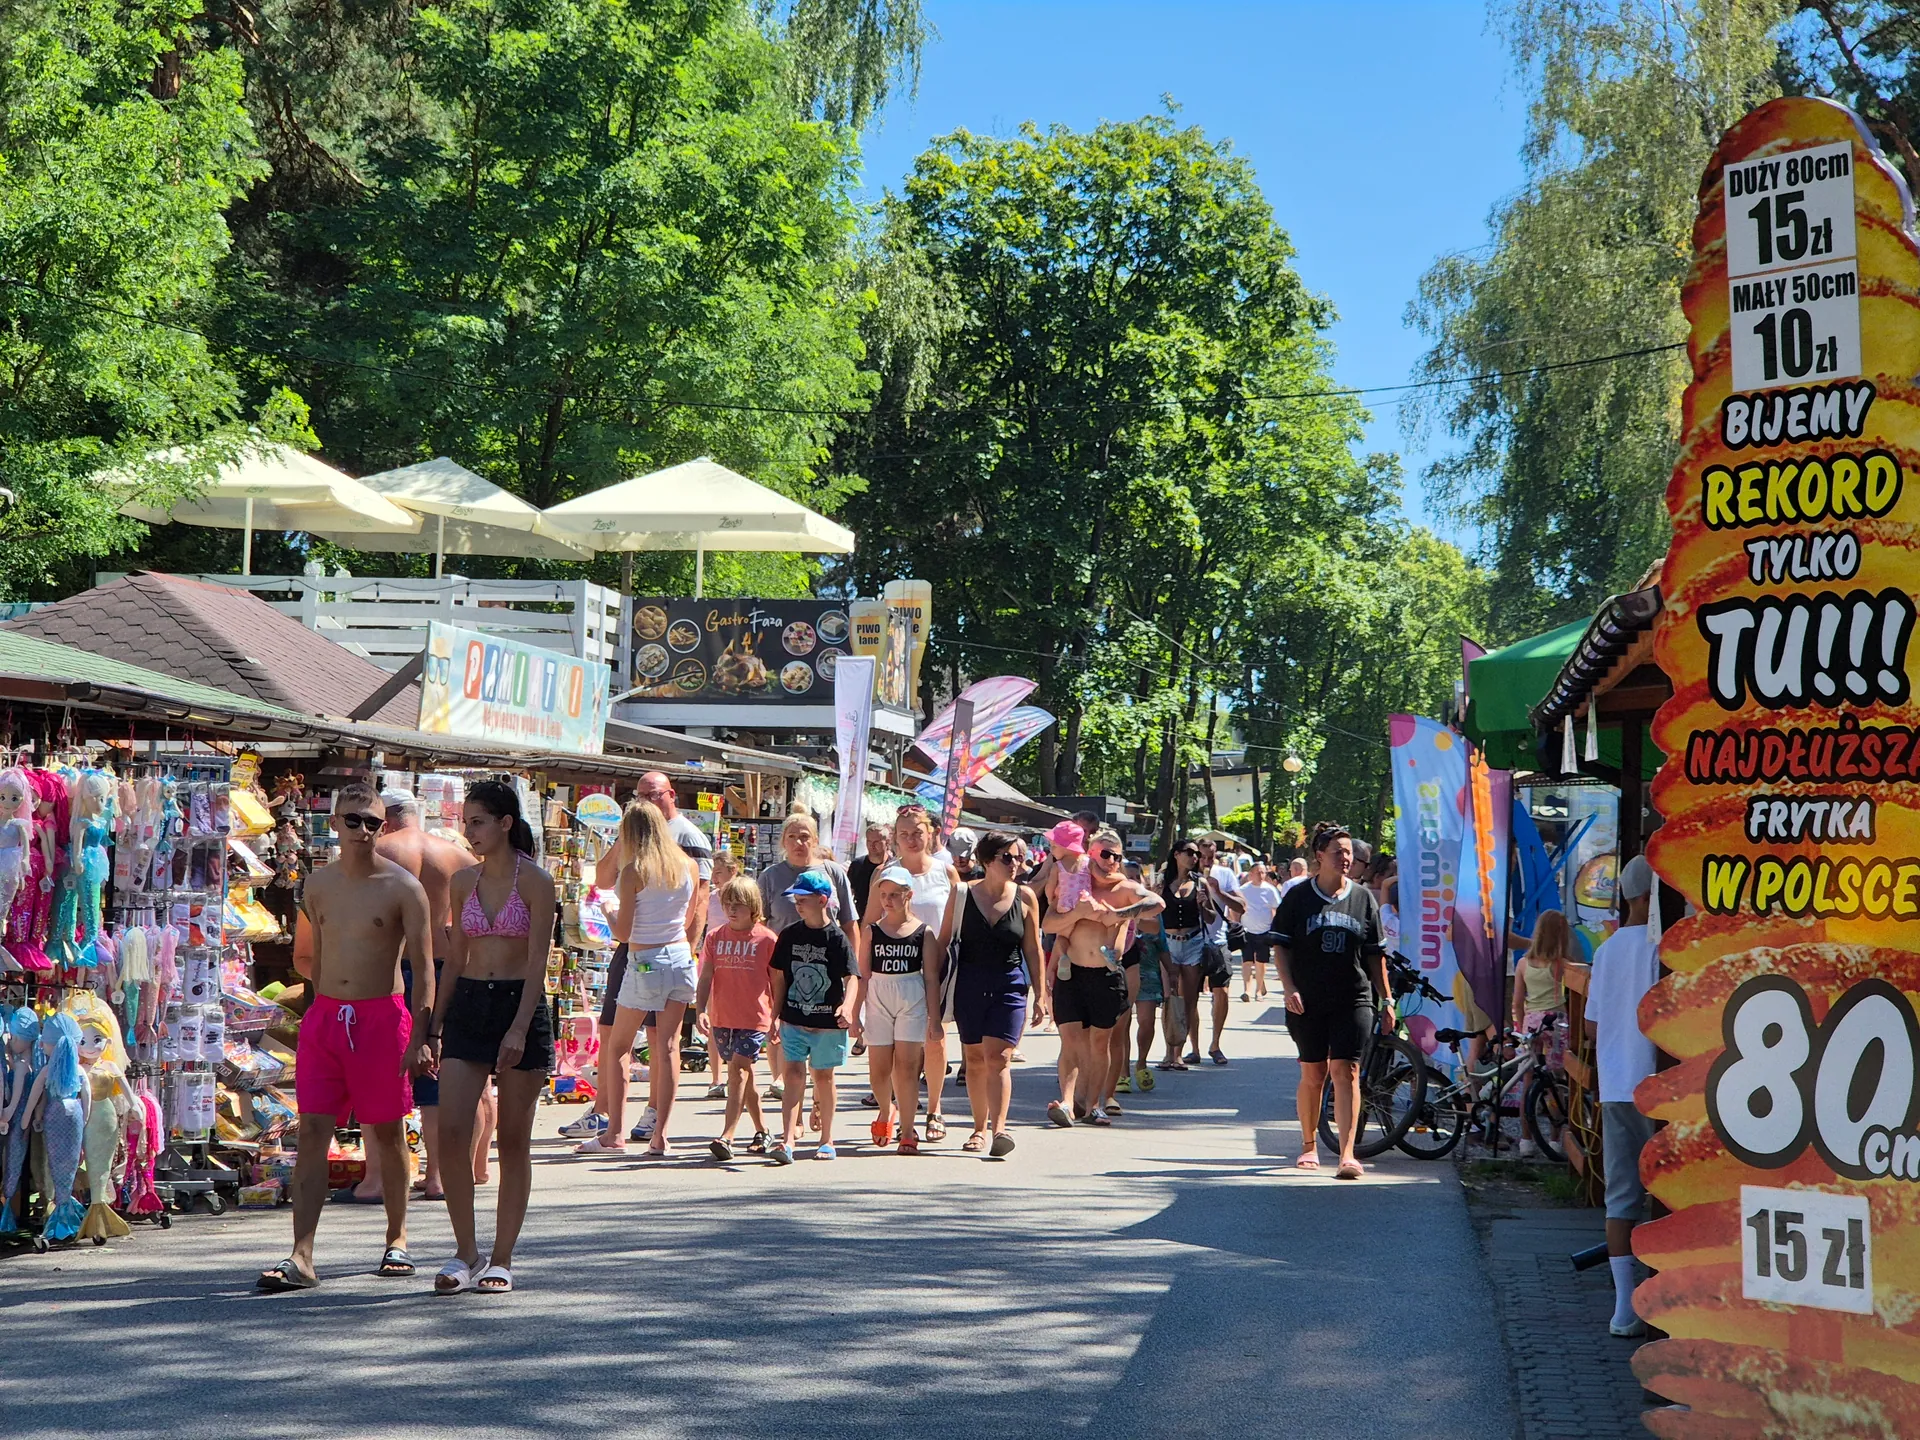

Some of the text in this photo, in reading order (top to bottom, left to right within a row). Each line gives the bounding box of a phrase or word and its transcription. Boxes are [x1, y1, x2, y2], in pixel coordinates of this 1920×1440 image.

[1729, 152, 1850, 198] DUŻY 80cm
[1733, 270, 1856, 313] MAŁY 50cm
[1725, 385, 1871, 445] BIJEMY
[1705, 454, 1898, 525] REKORD
[1747, 533, 1857, 581] TYLKO
[856, 623, 881, 634] PIWO
[858, 635, 879, 645] lane
[1705, 599, 1906, 700] TU!!!
[1750, 800, 1871, 838] FRYTKA
[1707, 860, 1747, 910] W
[1756, 861, 1920, 915] POLSCE
[716, 940, 759, 957] BRAVE
[724, 955, 746, 964] KIDS
[874, 943, 919, 958] FASHION
[1321, 930, 1346, 953] 91
[881, 959, 909, 972] ICON
[1716, 988, 1914, 1167] 80
[1746, 1208, 1865, 1290] 15 zł
